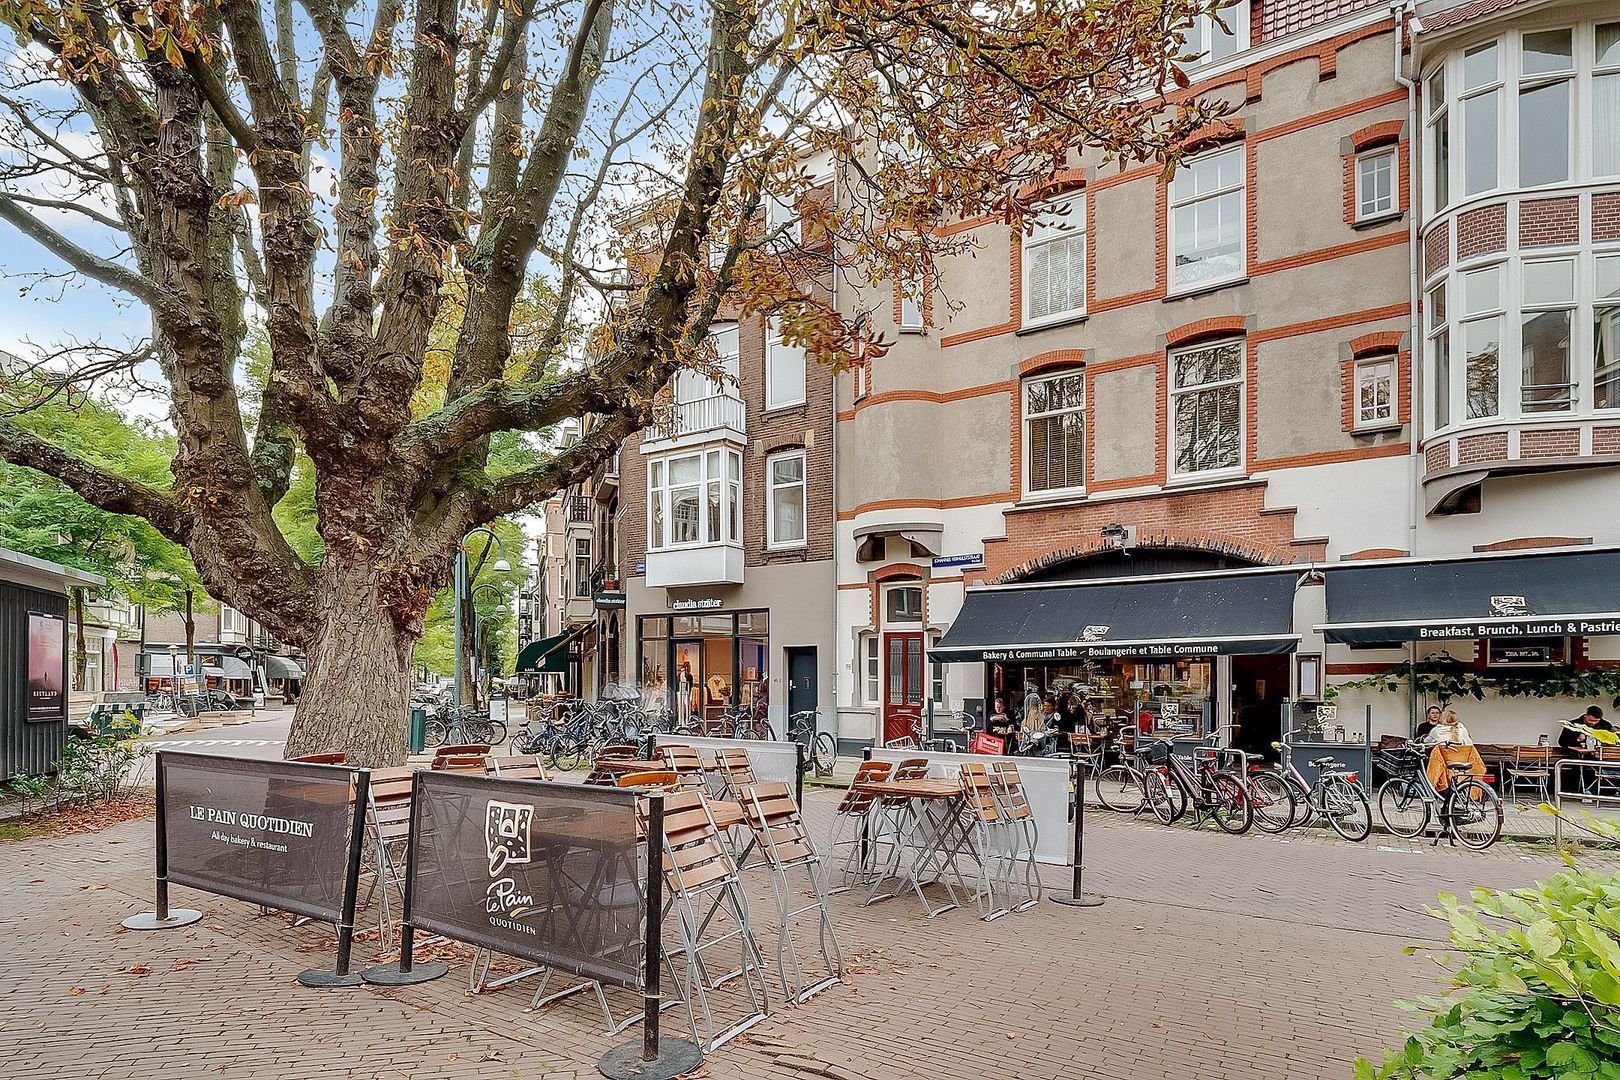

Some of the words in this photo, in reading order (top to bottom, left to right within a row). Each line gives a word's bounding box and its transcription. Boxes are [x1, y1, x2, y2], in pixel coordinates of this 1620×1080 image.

[673, 599, 697, 610] claudia
[1420, 626, 1475, 638] Breakfast,
[1478, 624, 1523, 636] Brunch,
[1526, 622, 1562, 634] Lunch
[1567, 622, 1577, 633] &
[983, 651, 1007, 660] Bakery
[1008, 650, 1015, 659] &
[1016, 648, 1055, 658] Communal
[1057, 647, 1077, 657] Table
[1088, 645, 1137, 657] Boulangerie
[1139, 645, 1148, 655] et
[1149, 644, 1172, 654] Table
[1174, 644, 1218, 654] Commune
[189, 805, 205, 821] LE
[207, 807, 237, 826] PAIN
[239, 812, 314, 838] QUOTIDIEN
[210, 830, 220, 840] All
[220, 832, 230, 845] day
[230, 834, 250, 849] bakery
[250, 837, 256, 848] &
[256, 840, 288, 853] restaurant
[487, 877, 533, 912] Pain
[489, 916, 537, 936] QUOTIDIEN
